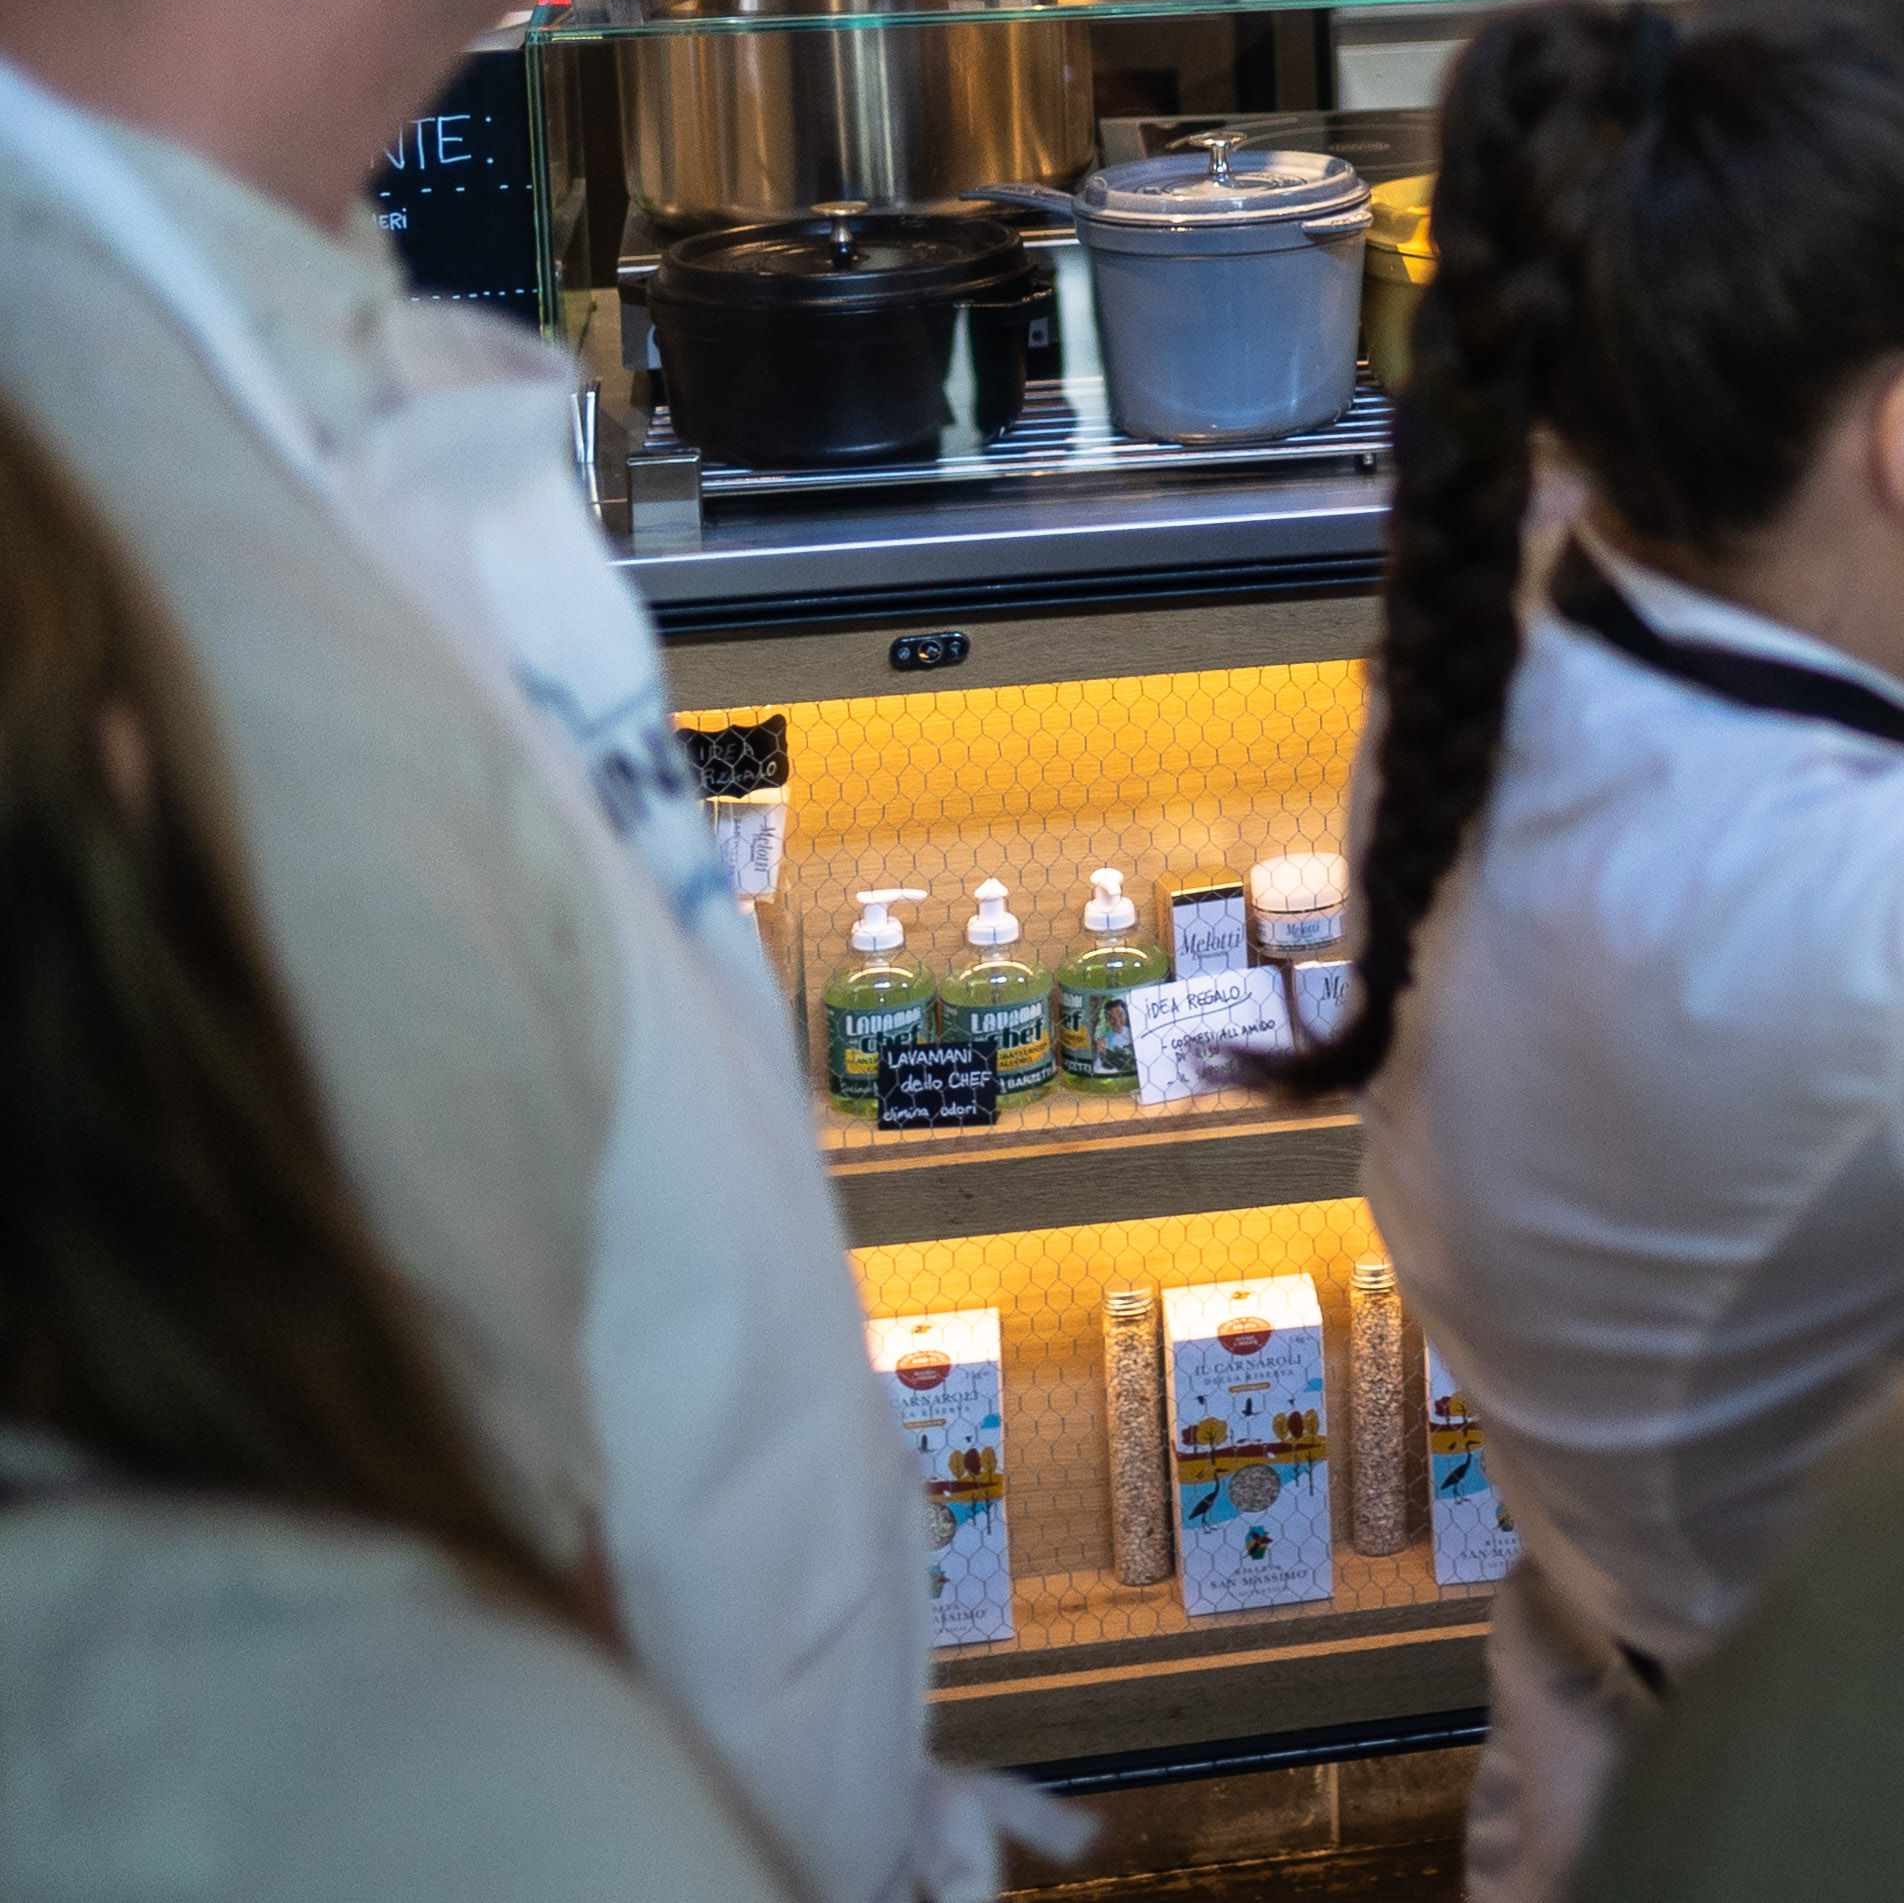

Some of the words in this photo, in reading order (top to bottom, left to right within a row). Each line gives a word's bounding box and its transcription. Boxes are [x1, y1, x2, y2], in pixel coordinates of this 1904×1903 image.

[1144, 997, 1179, 1020] IDEA
[1187, 985, 1241, 1010] REGALO
[888, 1049, 972, 1068] LAVAMANI
[901, 1074, 942, 1093] dello
[948, 1071, 993, 1089] CHEF
[940, 1100, 977, 1117] odori
